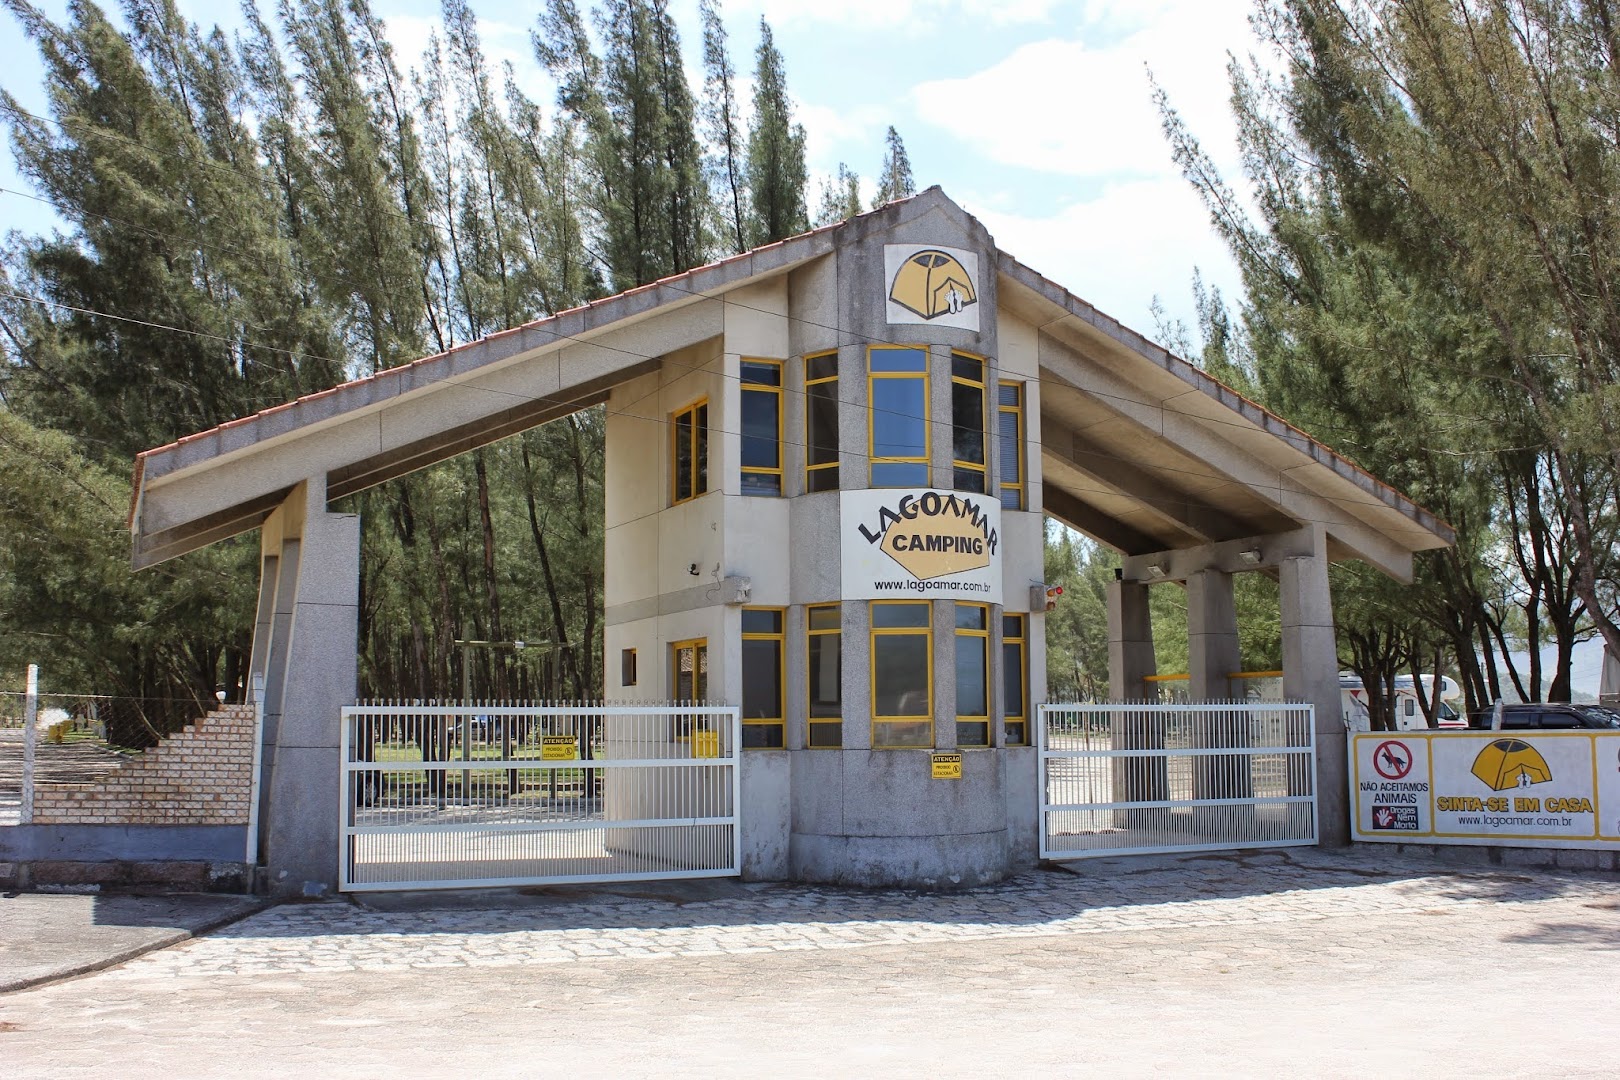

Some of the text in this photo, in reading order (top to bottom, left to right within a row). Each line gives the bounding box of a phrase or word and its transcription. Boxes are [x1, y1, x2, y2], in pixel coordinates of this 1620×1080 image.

[858, 491, 998, 556] LAGOAMAR
[892, 534, 983, 555] CAMPING
[874, 579, 991, 593] www.lagoamar.com.br
[1360, 781, 1429, 791] NÃO ACEITAMOS
[1374, 793, 1417, 804] ANIMAIS
[1437, 796, 1594, 813] SINTA-SE EM CASA
[1390, 807, 1416, 815] Drogas
[1394, 821, 1417, 829] Morto
[1458, 814, 1572, 828] www.lagoamar.com.br
